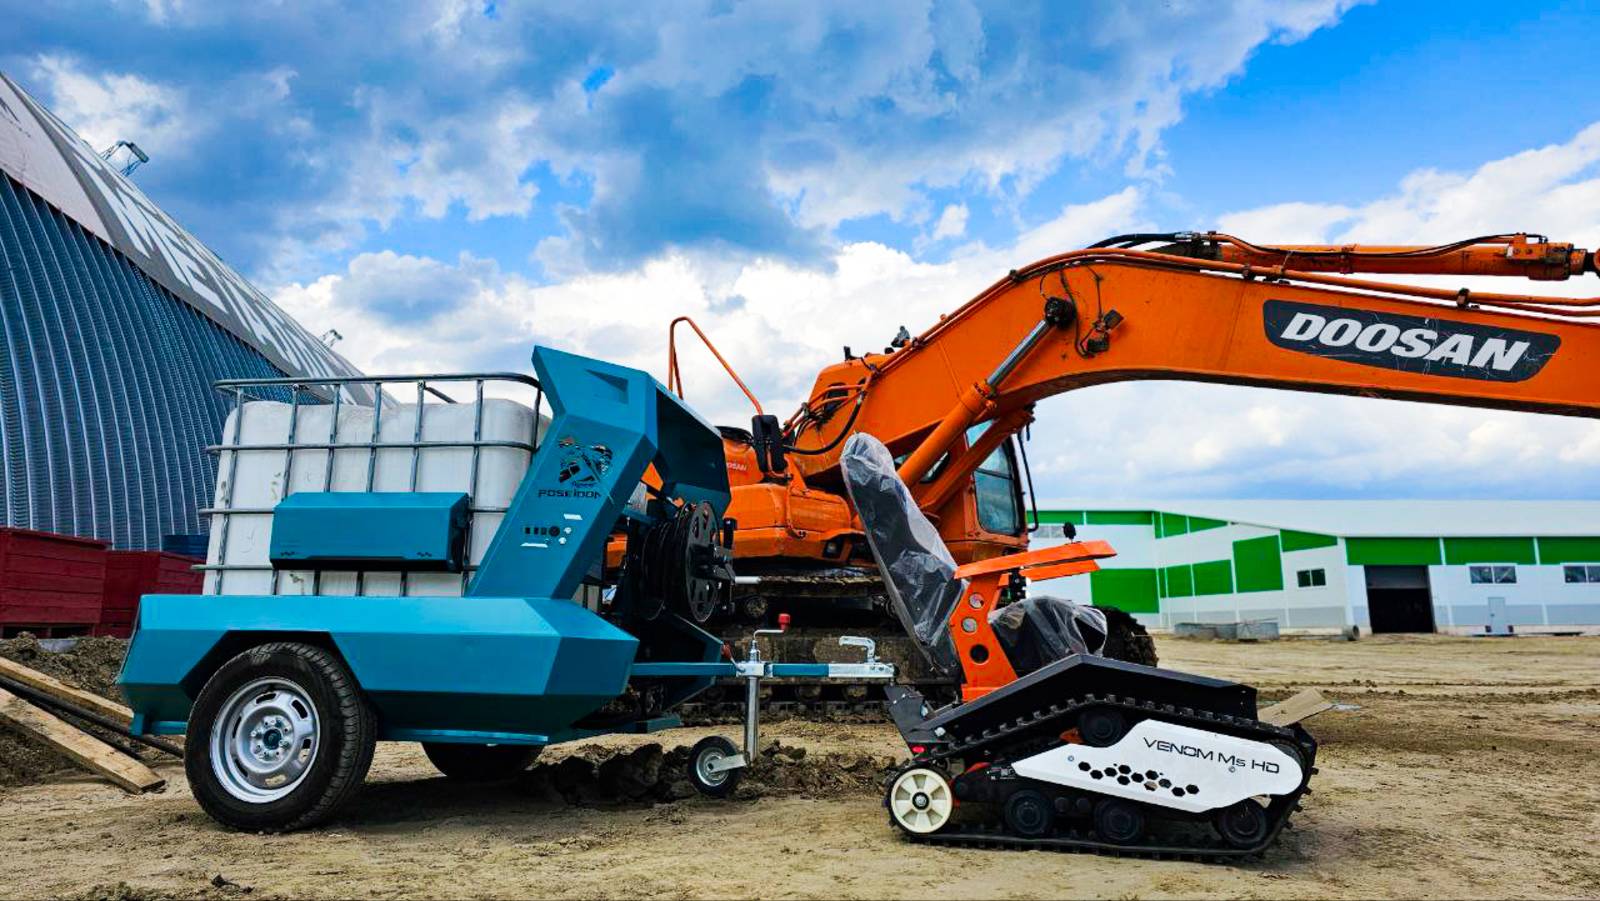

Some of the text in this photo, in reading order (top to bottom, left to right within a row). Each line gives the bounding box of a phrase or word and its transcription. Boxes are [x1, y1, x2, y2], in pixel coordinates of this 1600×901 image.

[1280, 312, 1530, 372] DOOSAN
[1143, 737, 1214, 760] VENOM
[1251, 759, 1280, 774] HD
